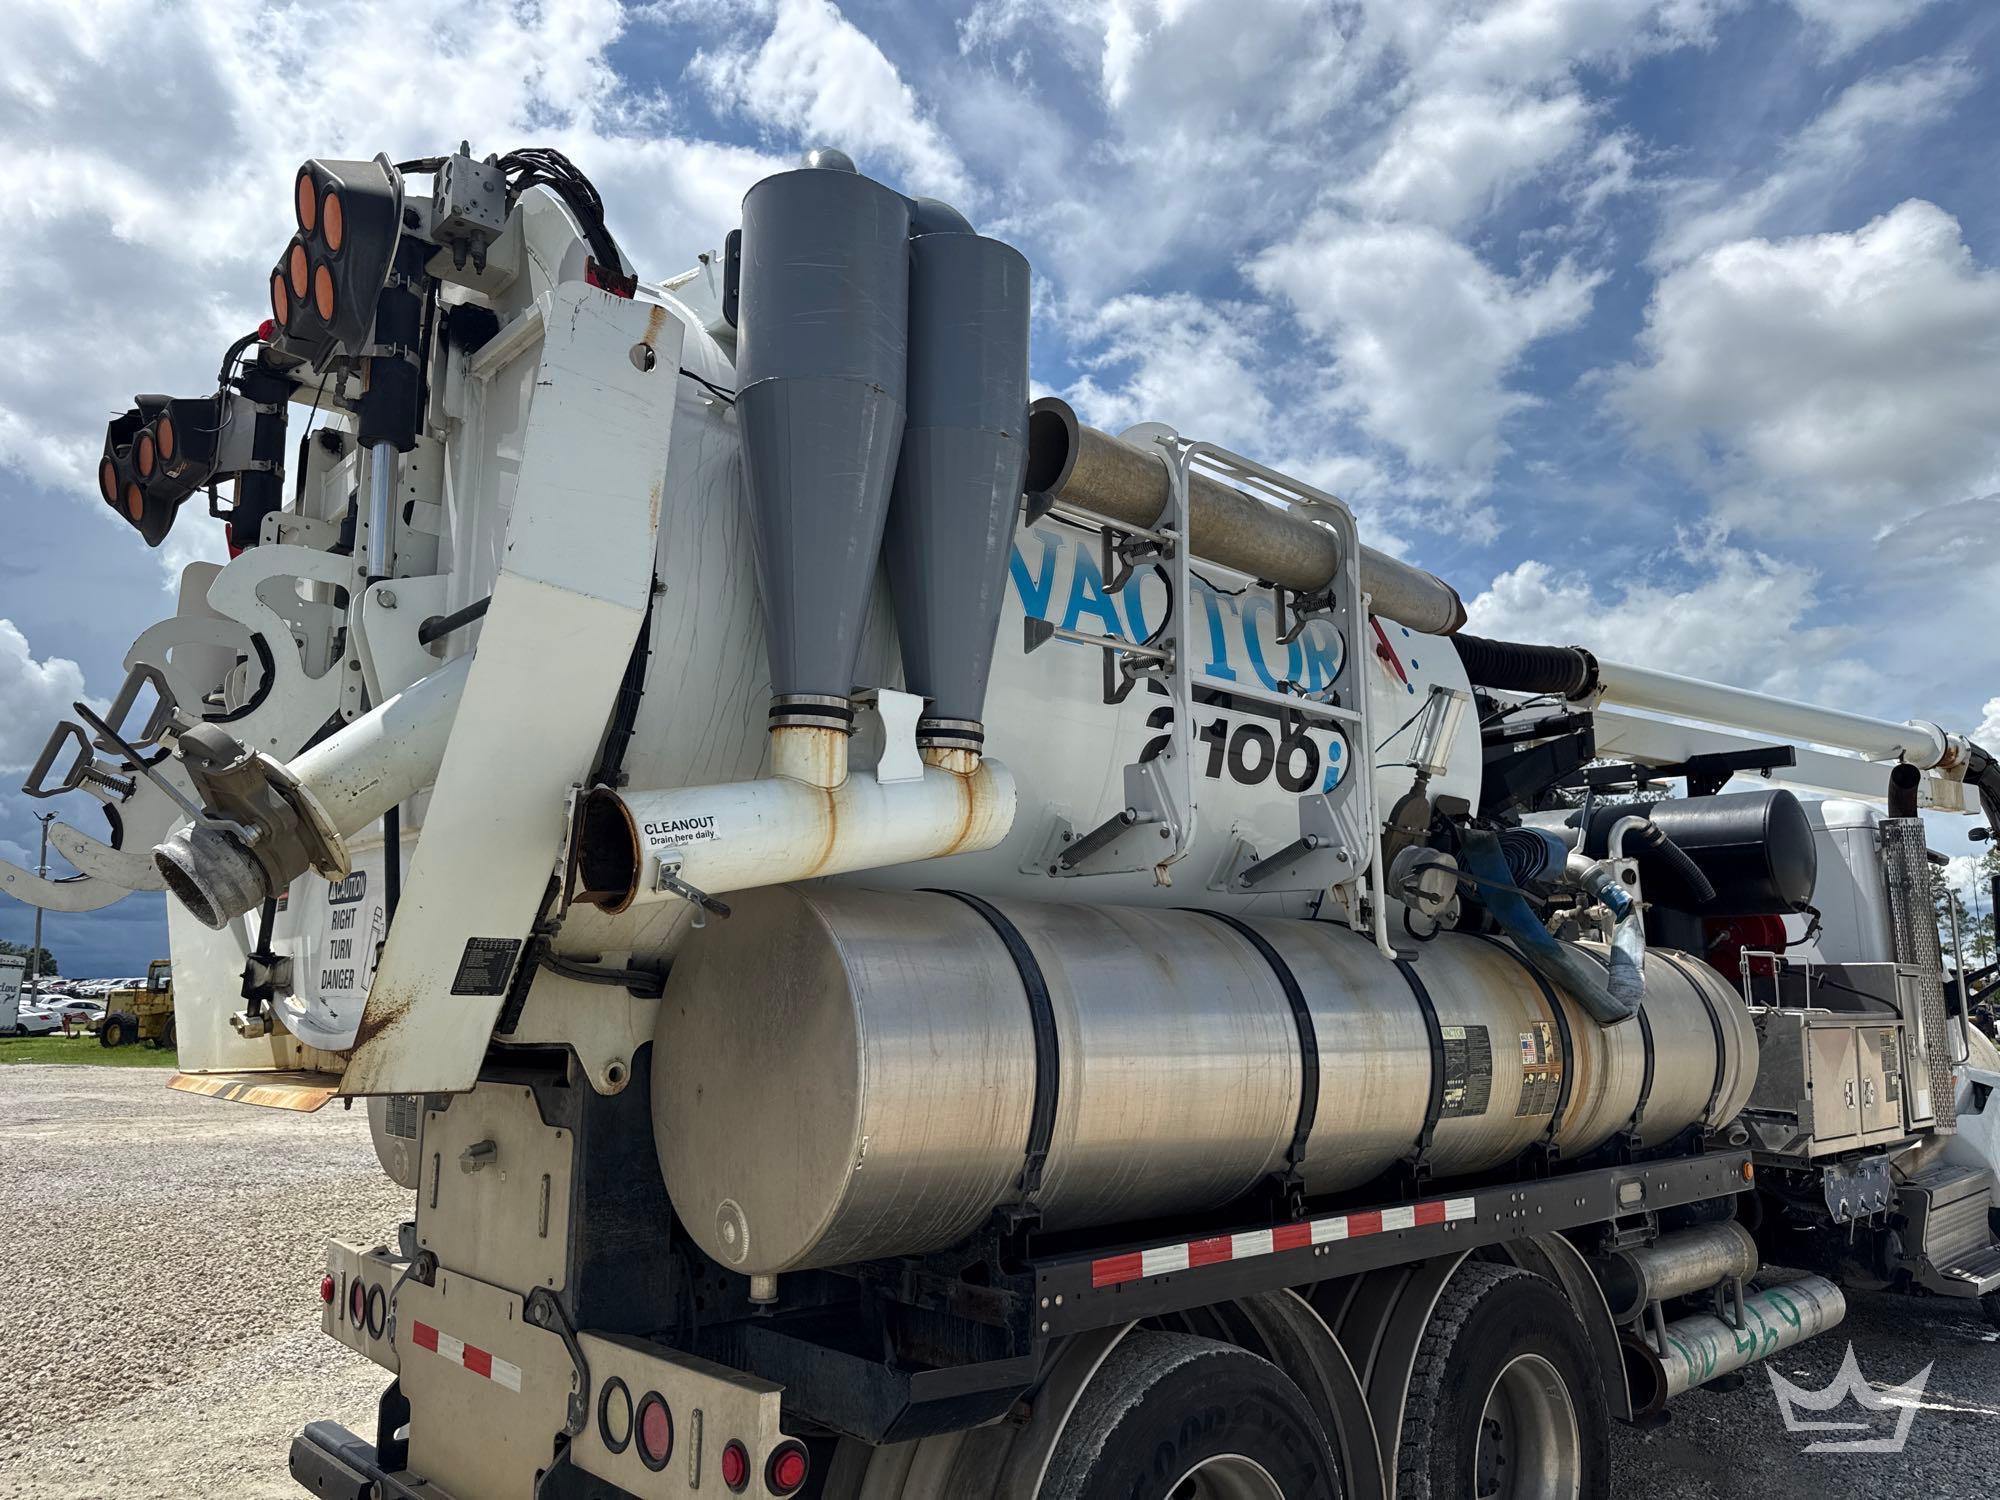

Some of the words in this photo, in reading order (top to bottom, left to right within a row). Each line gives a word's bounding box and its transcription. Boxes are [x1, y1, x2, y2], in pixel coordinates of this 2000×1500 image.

[1009, 527, 1341, 694] VACTOR
[645, 816, 714, 834] CLEANOUT
[650, 836, 673, 845] Drain
[675, 833, 694, 842] here
[695, 829, 715, 840] daily
[337, 875, 366, 899] CAUTION
[332, 908, 356, 930] RIGHT
[330, 938, 352, 960] TURN
[321, 969, 354, 990] DANGER
